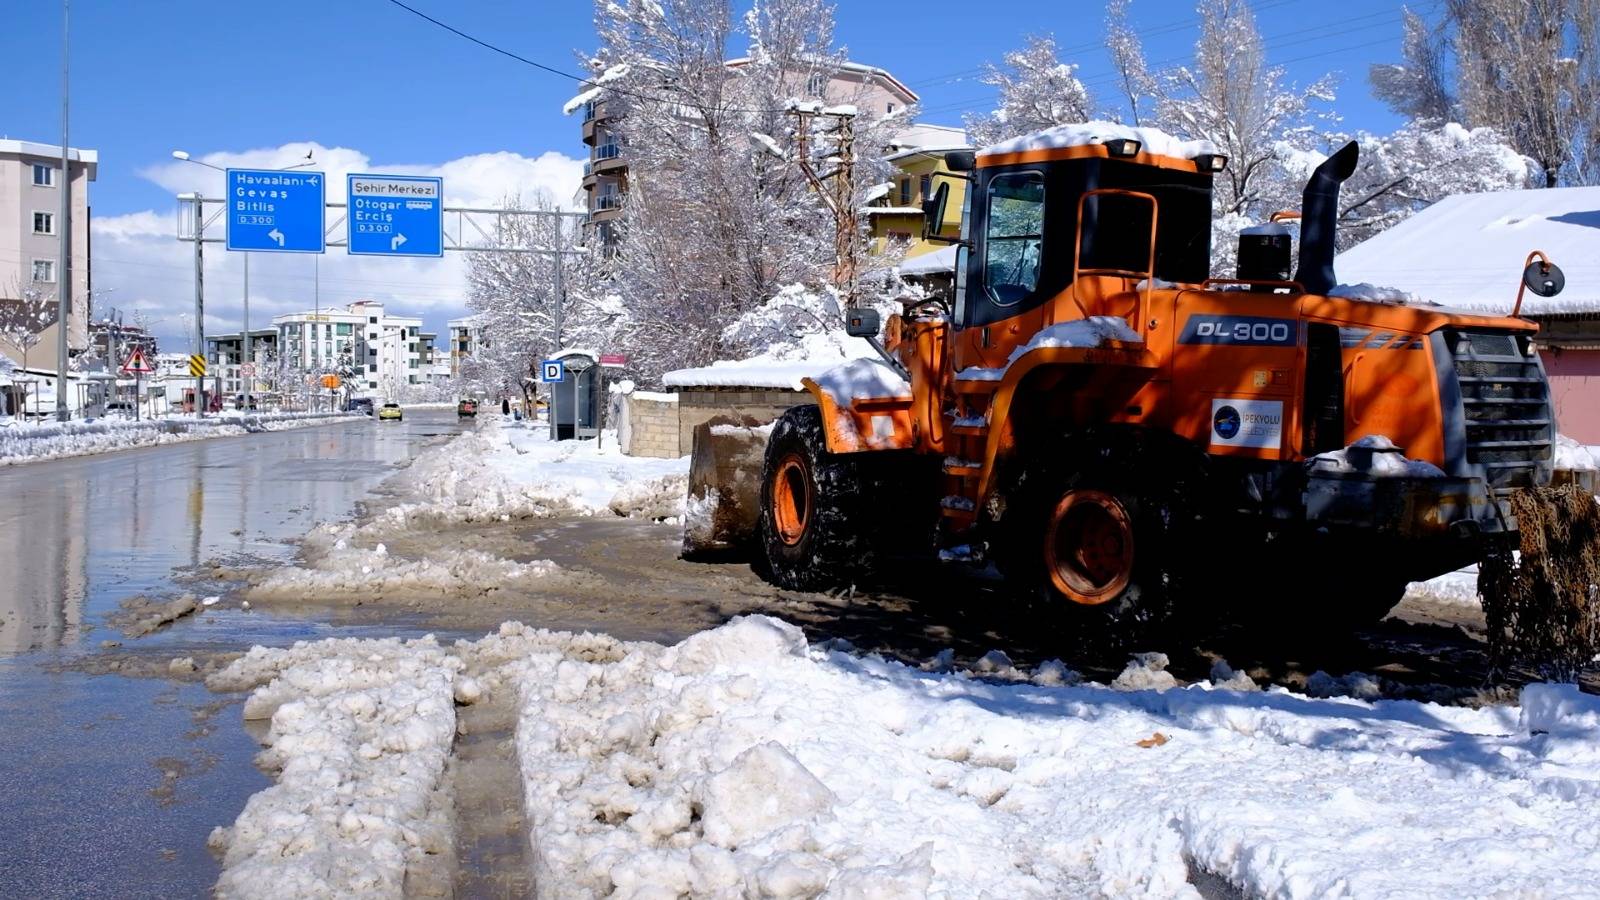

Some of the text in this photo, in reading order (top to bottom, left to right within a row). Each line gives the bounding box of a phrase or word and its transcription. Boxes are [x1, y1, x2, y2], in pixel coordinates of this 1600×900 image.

[237, 174, 304, 186] Havaalanı
[236, 187, 288, 200] Gevaş
[355, 182, 435, 195] Şehir Merkezi
[236, 201, 275, 212] Bitlis
[355, 198, 402, 211] Otogar
[355, 211, 393, 222] Erciş
[548, 365, 558, 377] D
